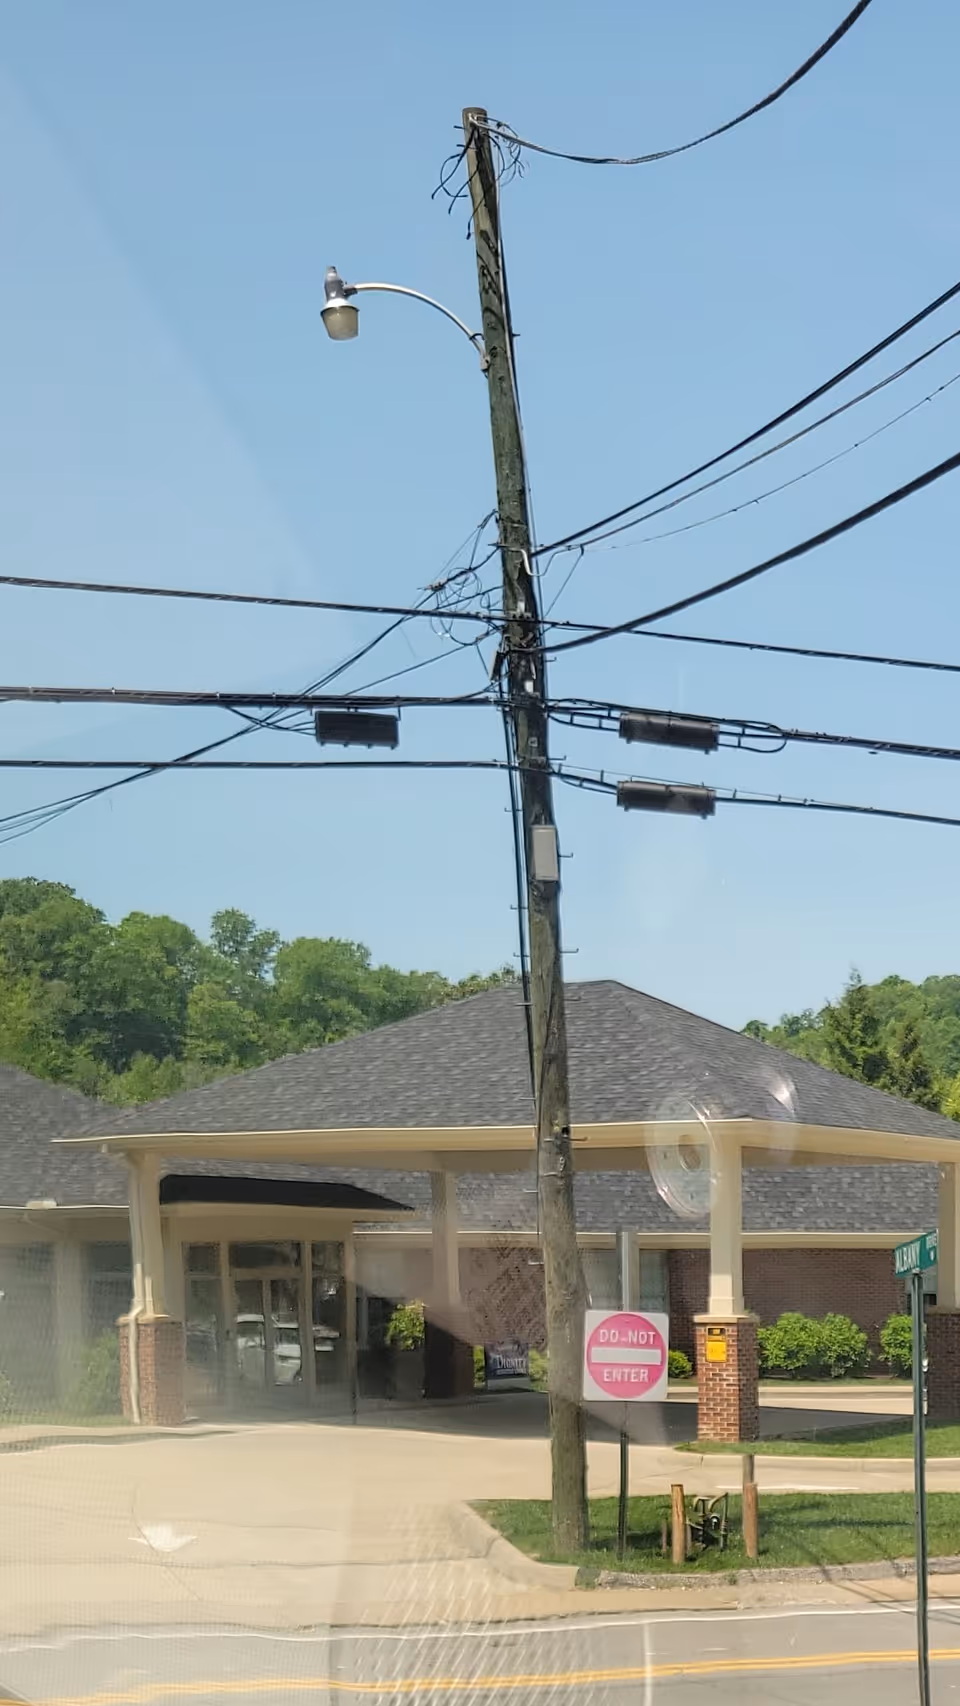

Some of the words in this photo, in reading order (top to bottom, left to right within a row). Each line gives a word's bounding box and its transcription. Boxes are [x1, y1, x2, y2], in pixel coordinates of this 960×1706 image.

[895, 1241, 920, 1274] ALBANY
[600, 1329, 619, 1343] DO
[628, 1330, 656, 1345] NOT
[603, 1368, 649, 1382] ENTER
